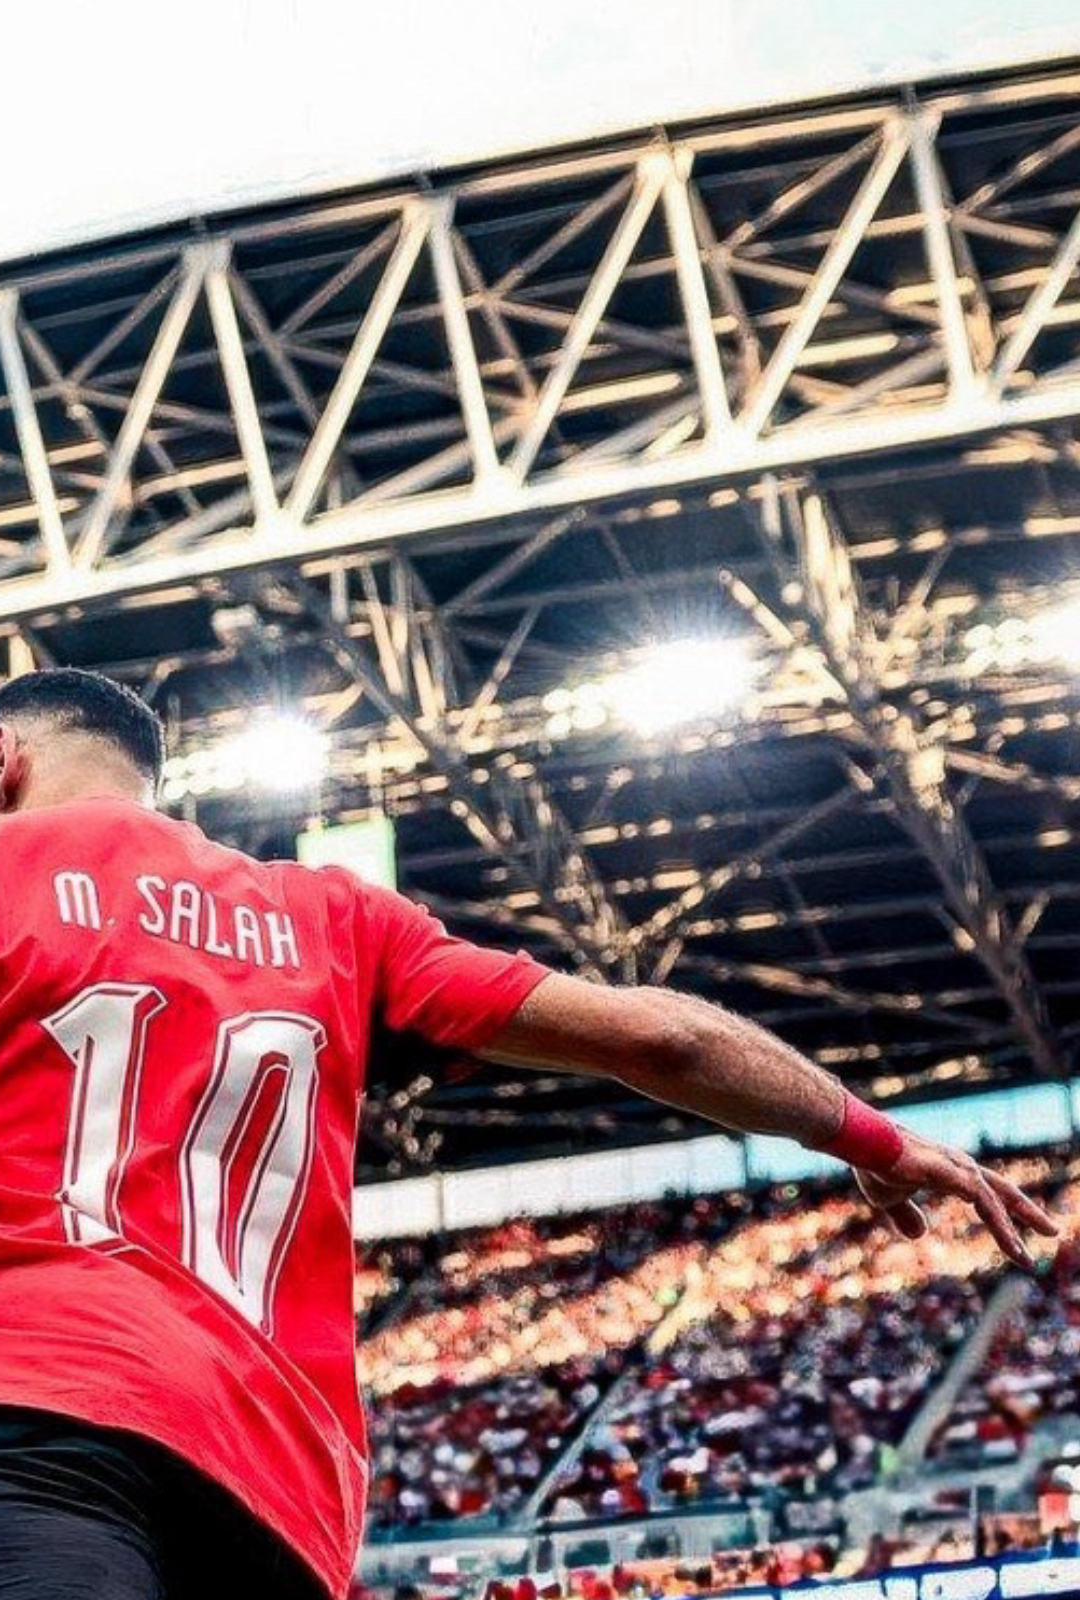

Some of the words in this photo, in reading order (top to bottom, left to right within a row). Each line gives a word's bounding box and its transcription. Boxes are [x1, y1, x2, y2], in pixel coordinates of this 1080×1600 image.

[53, 870, 116, 931] M.
[136, 874, 301, 969] SALAH
[40, 980, 328, 1341] 10
